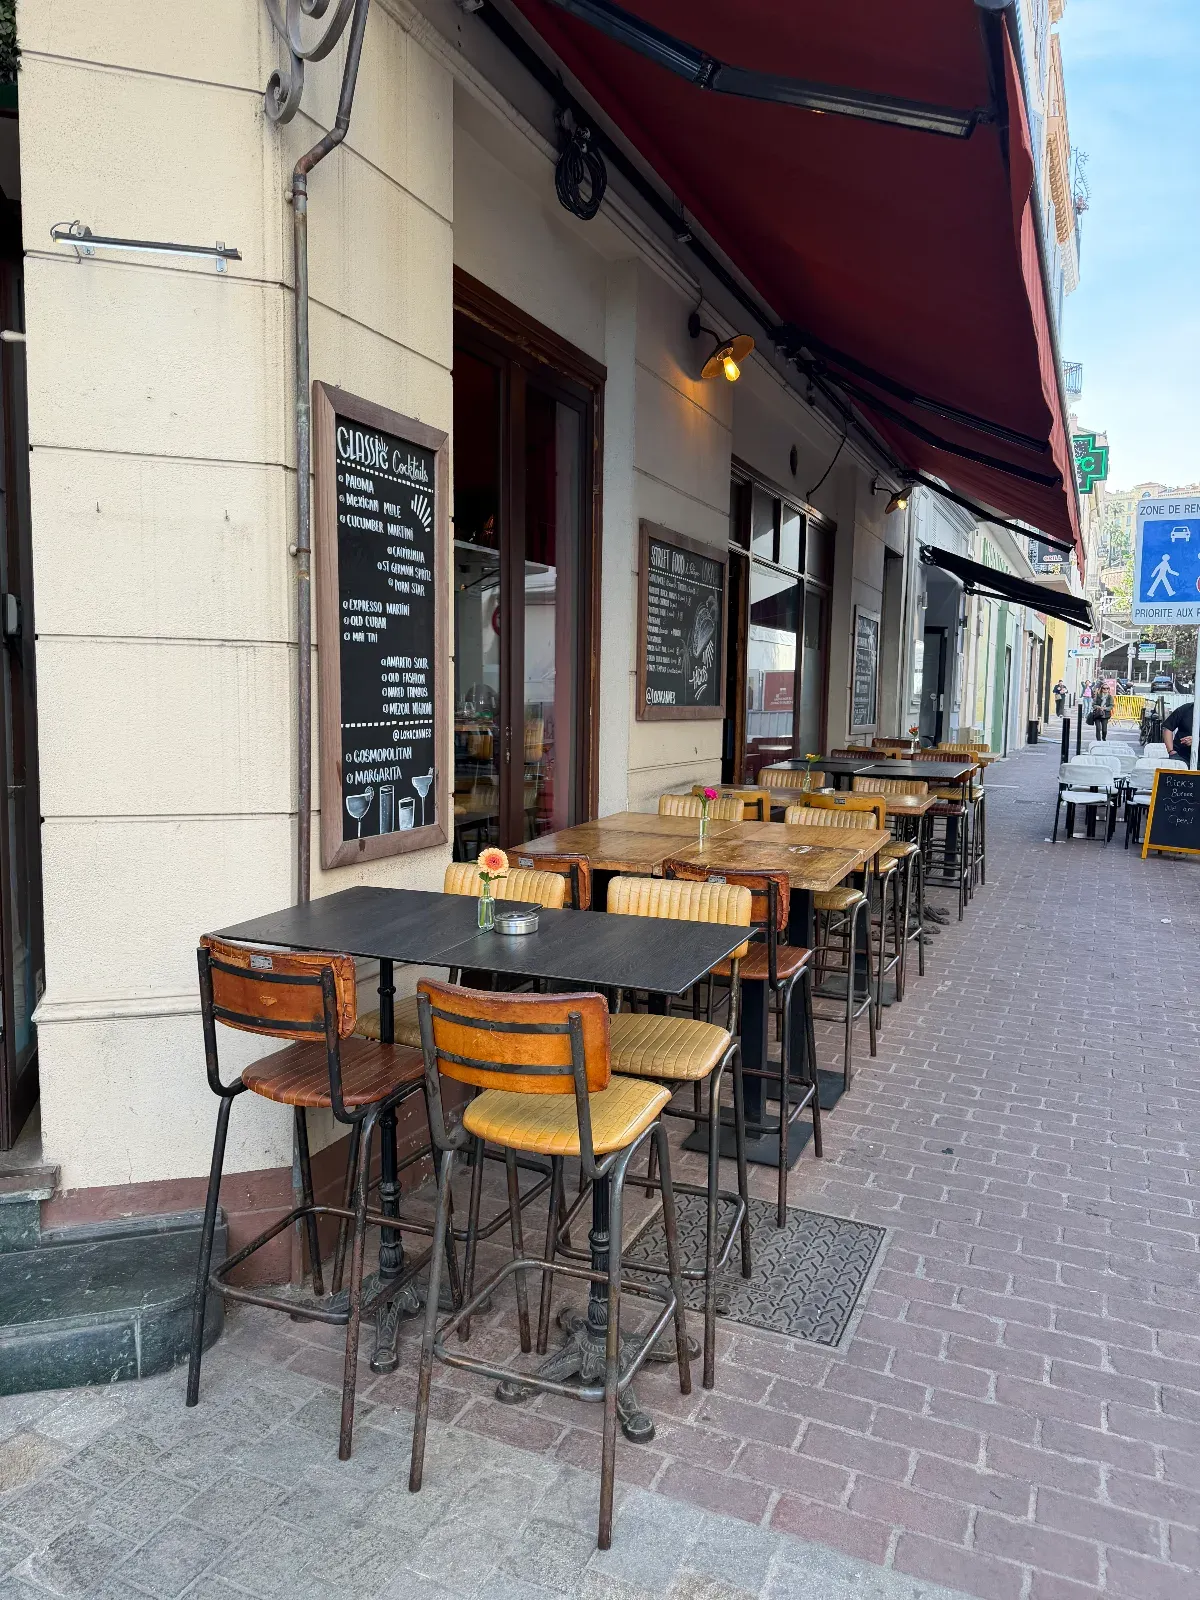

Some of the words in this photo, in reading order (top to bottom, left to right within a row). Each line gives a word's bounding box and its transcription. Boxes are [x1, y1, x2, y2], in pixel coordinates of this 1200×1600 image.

[337, 426, 389, 470] CLASSIC
[392, 450, 429, 483] Cocktails
[345, 473, 375, 494] PALOMA
[383, 501, 401, 519] MULE
[1140, 505, 1165, 516] ZONE
[1168, 504, 1181, 514] DE
[346, 514, 385, 534] CUCUMBER
[650, 545, 670, 570] STREET
[671, 551, 685, 575] FOOD
[411, 582, 426, 597] STAR
[349, 598, 383, 614] EXPRESSO
[1134, 608, 1173, 618] PRIORITE
[1176, 607, 1194, 618] AUX
[350, 615, 363, 627] OLD
[365, 615, 387, 629] CUBAN
[413, 656, 429, 669] SOUR
[388, 672, 399, 683] OLD
[389, 702, 410, 715] MEZCAL
[353, 746, 412, 764] COSMOPOLITAN
[354, 765, 402, 785] MARGARITA
